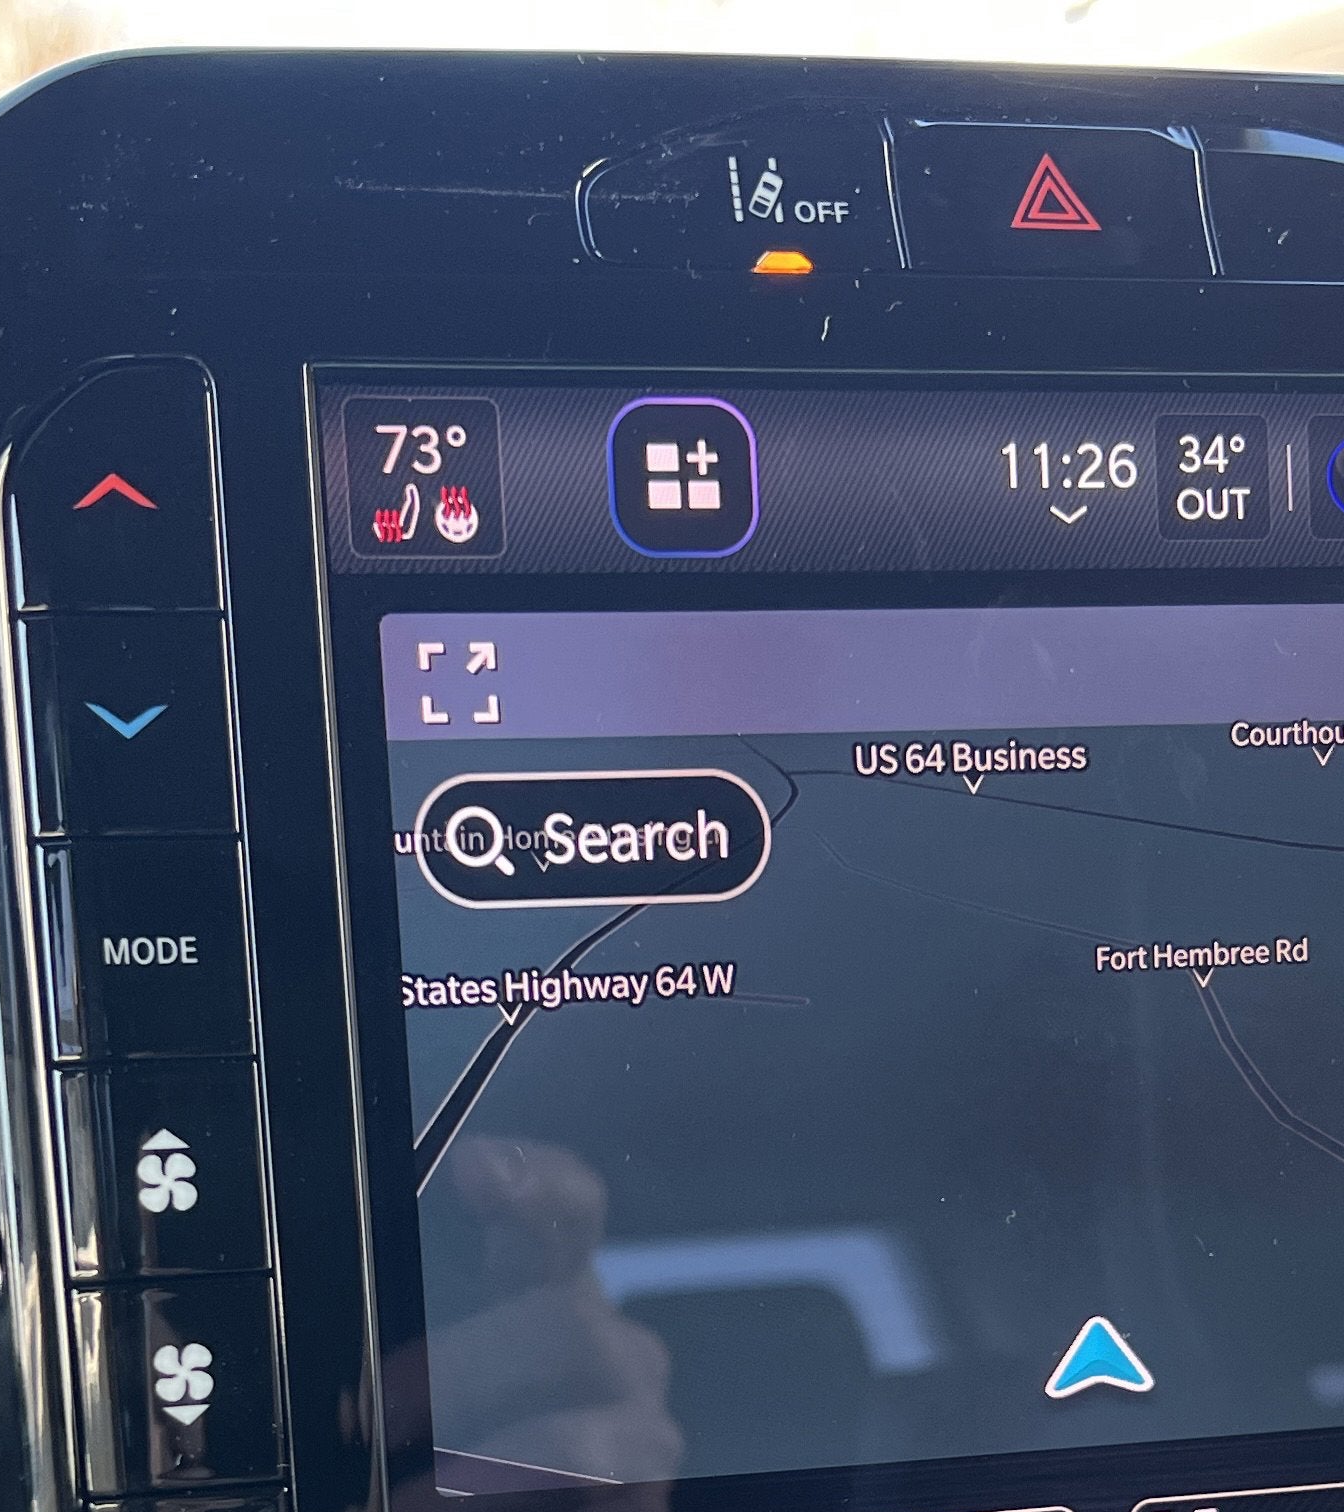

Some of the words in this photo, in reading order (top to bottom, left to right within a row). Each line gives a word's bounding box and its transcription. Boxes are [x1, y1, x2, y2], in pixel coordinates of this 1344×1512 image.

[794, 201, 850, 223] OFF
[374, 424, 467, 474] 73°
[1001, 442, 1138, 490] 11:26
[1178, 434, 1246, 473] 34°
[1176, 488, 1250, 521] OUT
[855, 745, 900, 774] US
[905, 743, 945, 772] 64
[953, 742, 1087, 772] Business
[544, 809, 729, 864] Search
[103, 937, 198, 966] MODE
[1096, 945, 1148, 971] Fort
[1154, 941, 1270, 969] Hembree
[1277, 938, 1309, 962] Rd
[402, 975, 497, 1007] States
[505, 968, 648, 1008] Highway
[655, 965, 696, 996] 64
[703, 964, 733, 995] W
